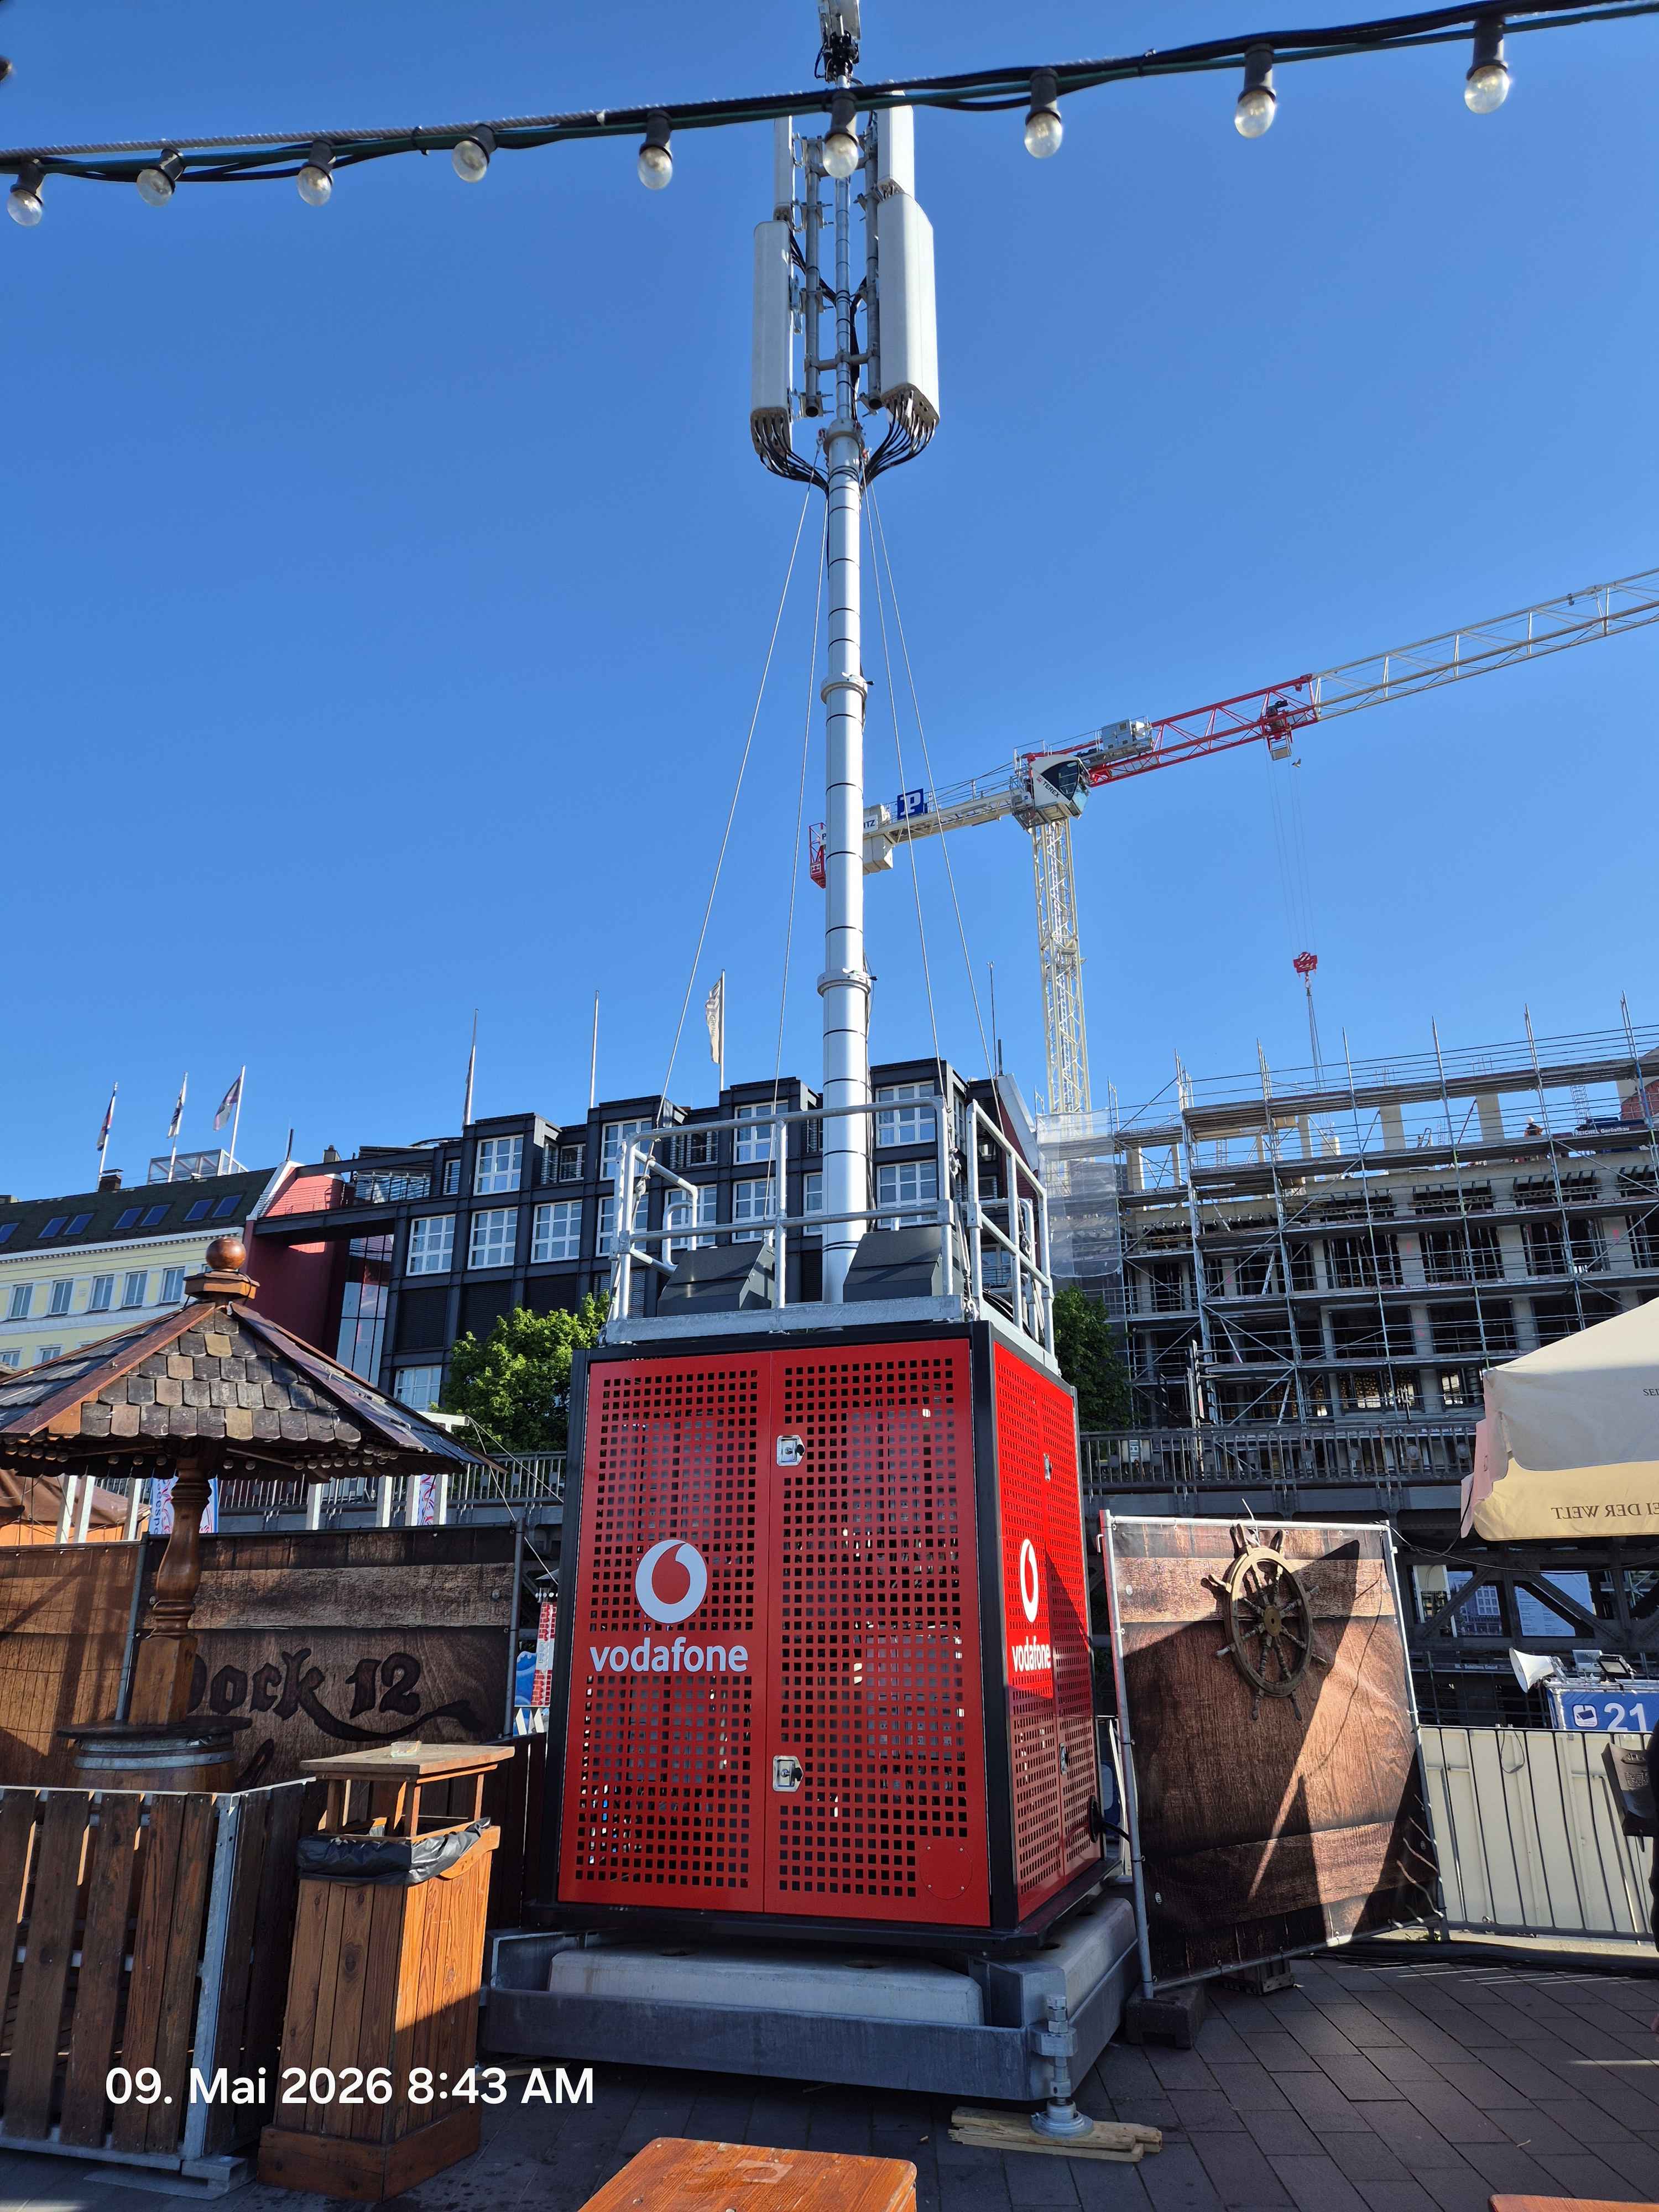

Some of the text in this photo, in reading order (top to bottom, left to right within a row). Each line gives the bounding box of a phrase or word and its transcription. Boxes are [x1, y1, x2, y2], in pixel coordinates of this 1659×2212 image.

[899, 792, 921, 816] P
[1042, 780, 1061, 798] TEREX
[863, 819, 875, 829] ITZ
[589, 1636, 748, 1672] vodafone
[1011, 1635, 1051, 1672] vodafone
[345, 1652, 421, 1719] 12
[1604, 1702, 1647, 1732] 21
